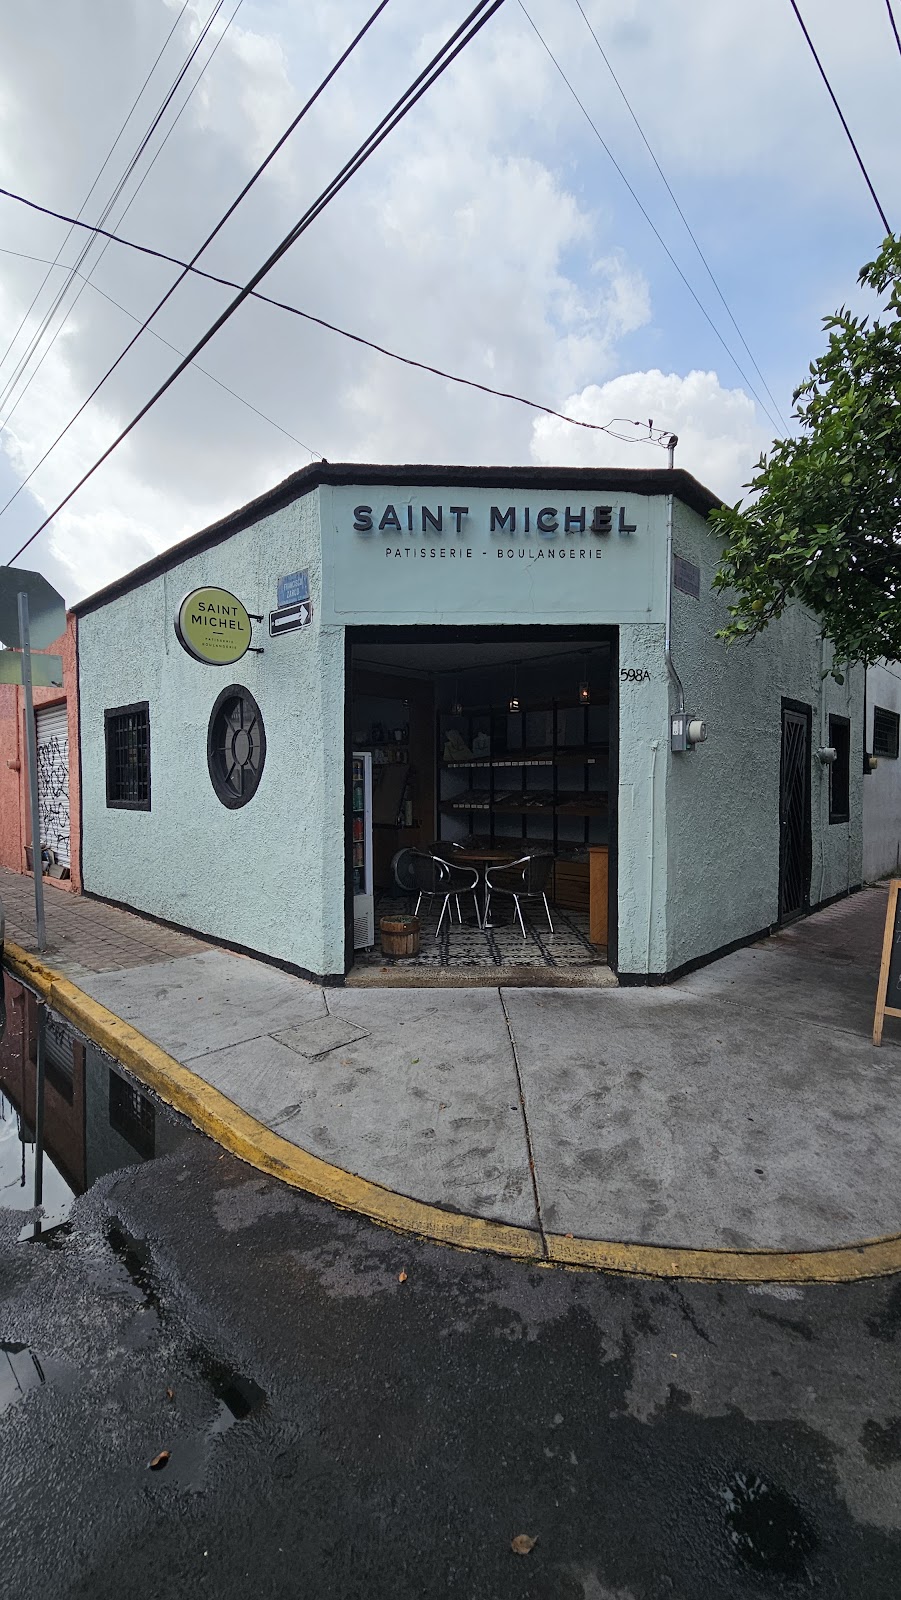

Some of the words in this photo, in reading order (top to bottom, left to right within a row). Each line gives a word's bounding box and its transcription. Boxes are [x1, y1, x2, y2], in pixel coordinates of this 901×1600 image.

[353, 505, 469, 532] SAINT
[490, 506, 637, 533] MICHEL
[385, 548, 473, 558] PATISSERIE
[497, 549, 602, 559] BOULANGERIE
[198, 602, 238, 617] SAINT
[191, 614, 245, 631] MICHEL
[620, 668, 651, 682] 598A
